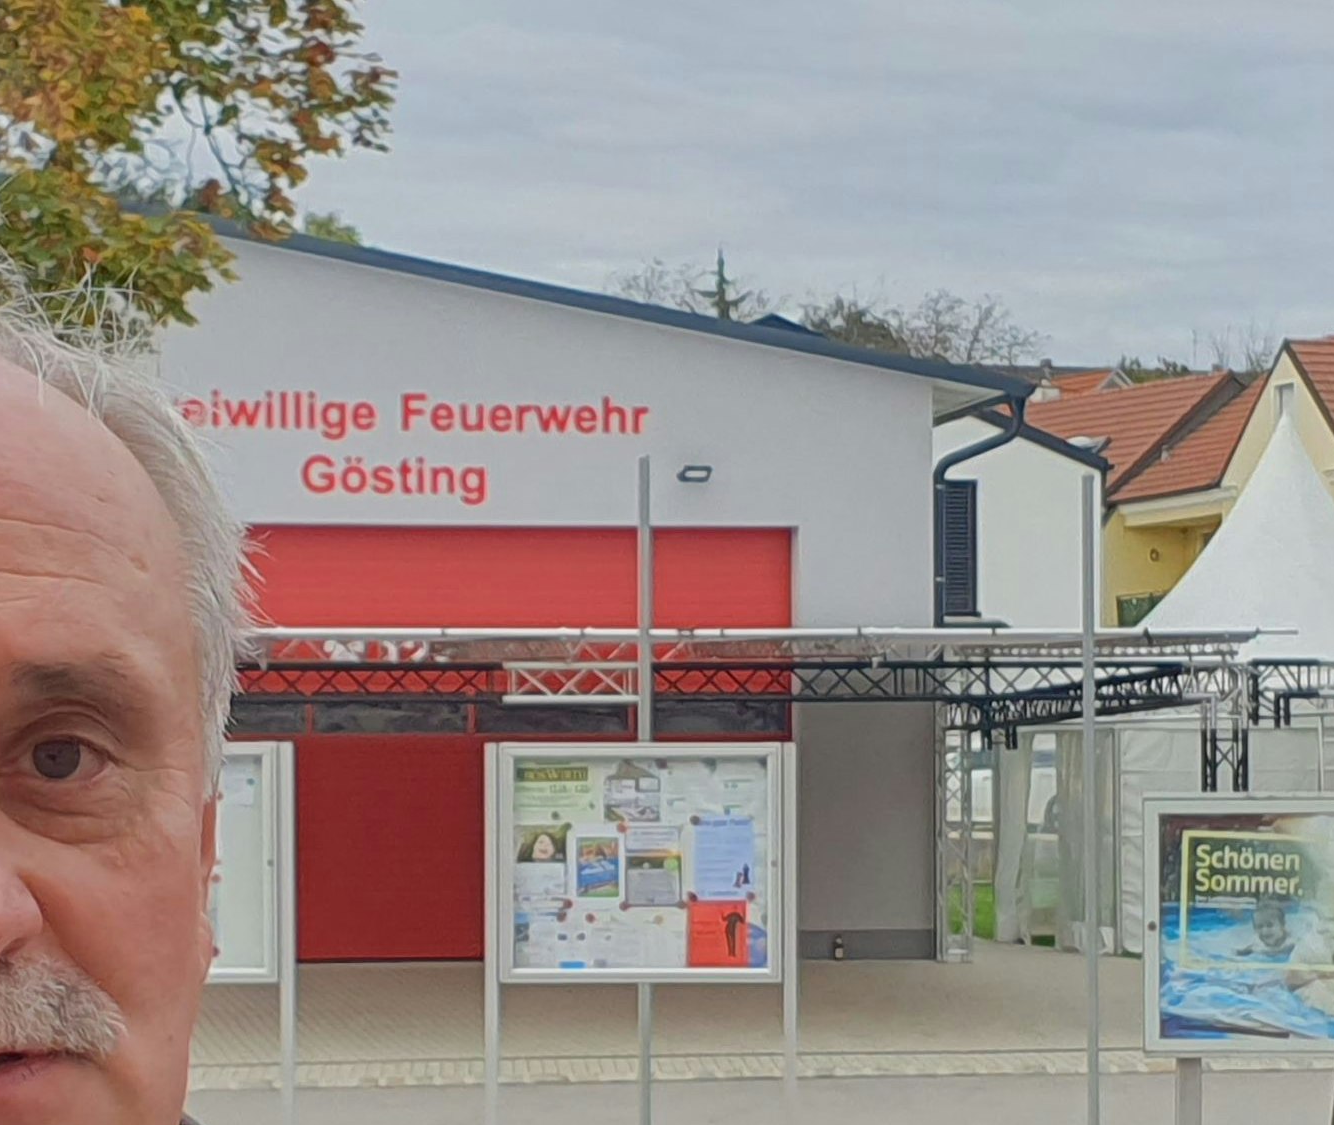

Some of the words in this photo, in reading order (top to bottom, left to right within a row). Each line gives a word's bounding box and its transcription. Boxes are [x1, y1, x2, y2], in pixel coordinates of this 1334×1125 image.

[175, 389, 376, 440] eiwillige
[400, 391, 650, 435] Feuerwehr
[300, 454, 487, 505] Gösting
[1195, 844, 1301, 871] Schönen
[1195, 868, 1304, 897] Sommer.
